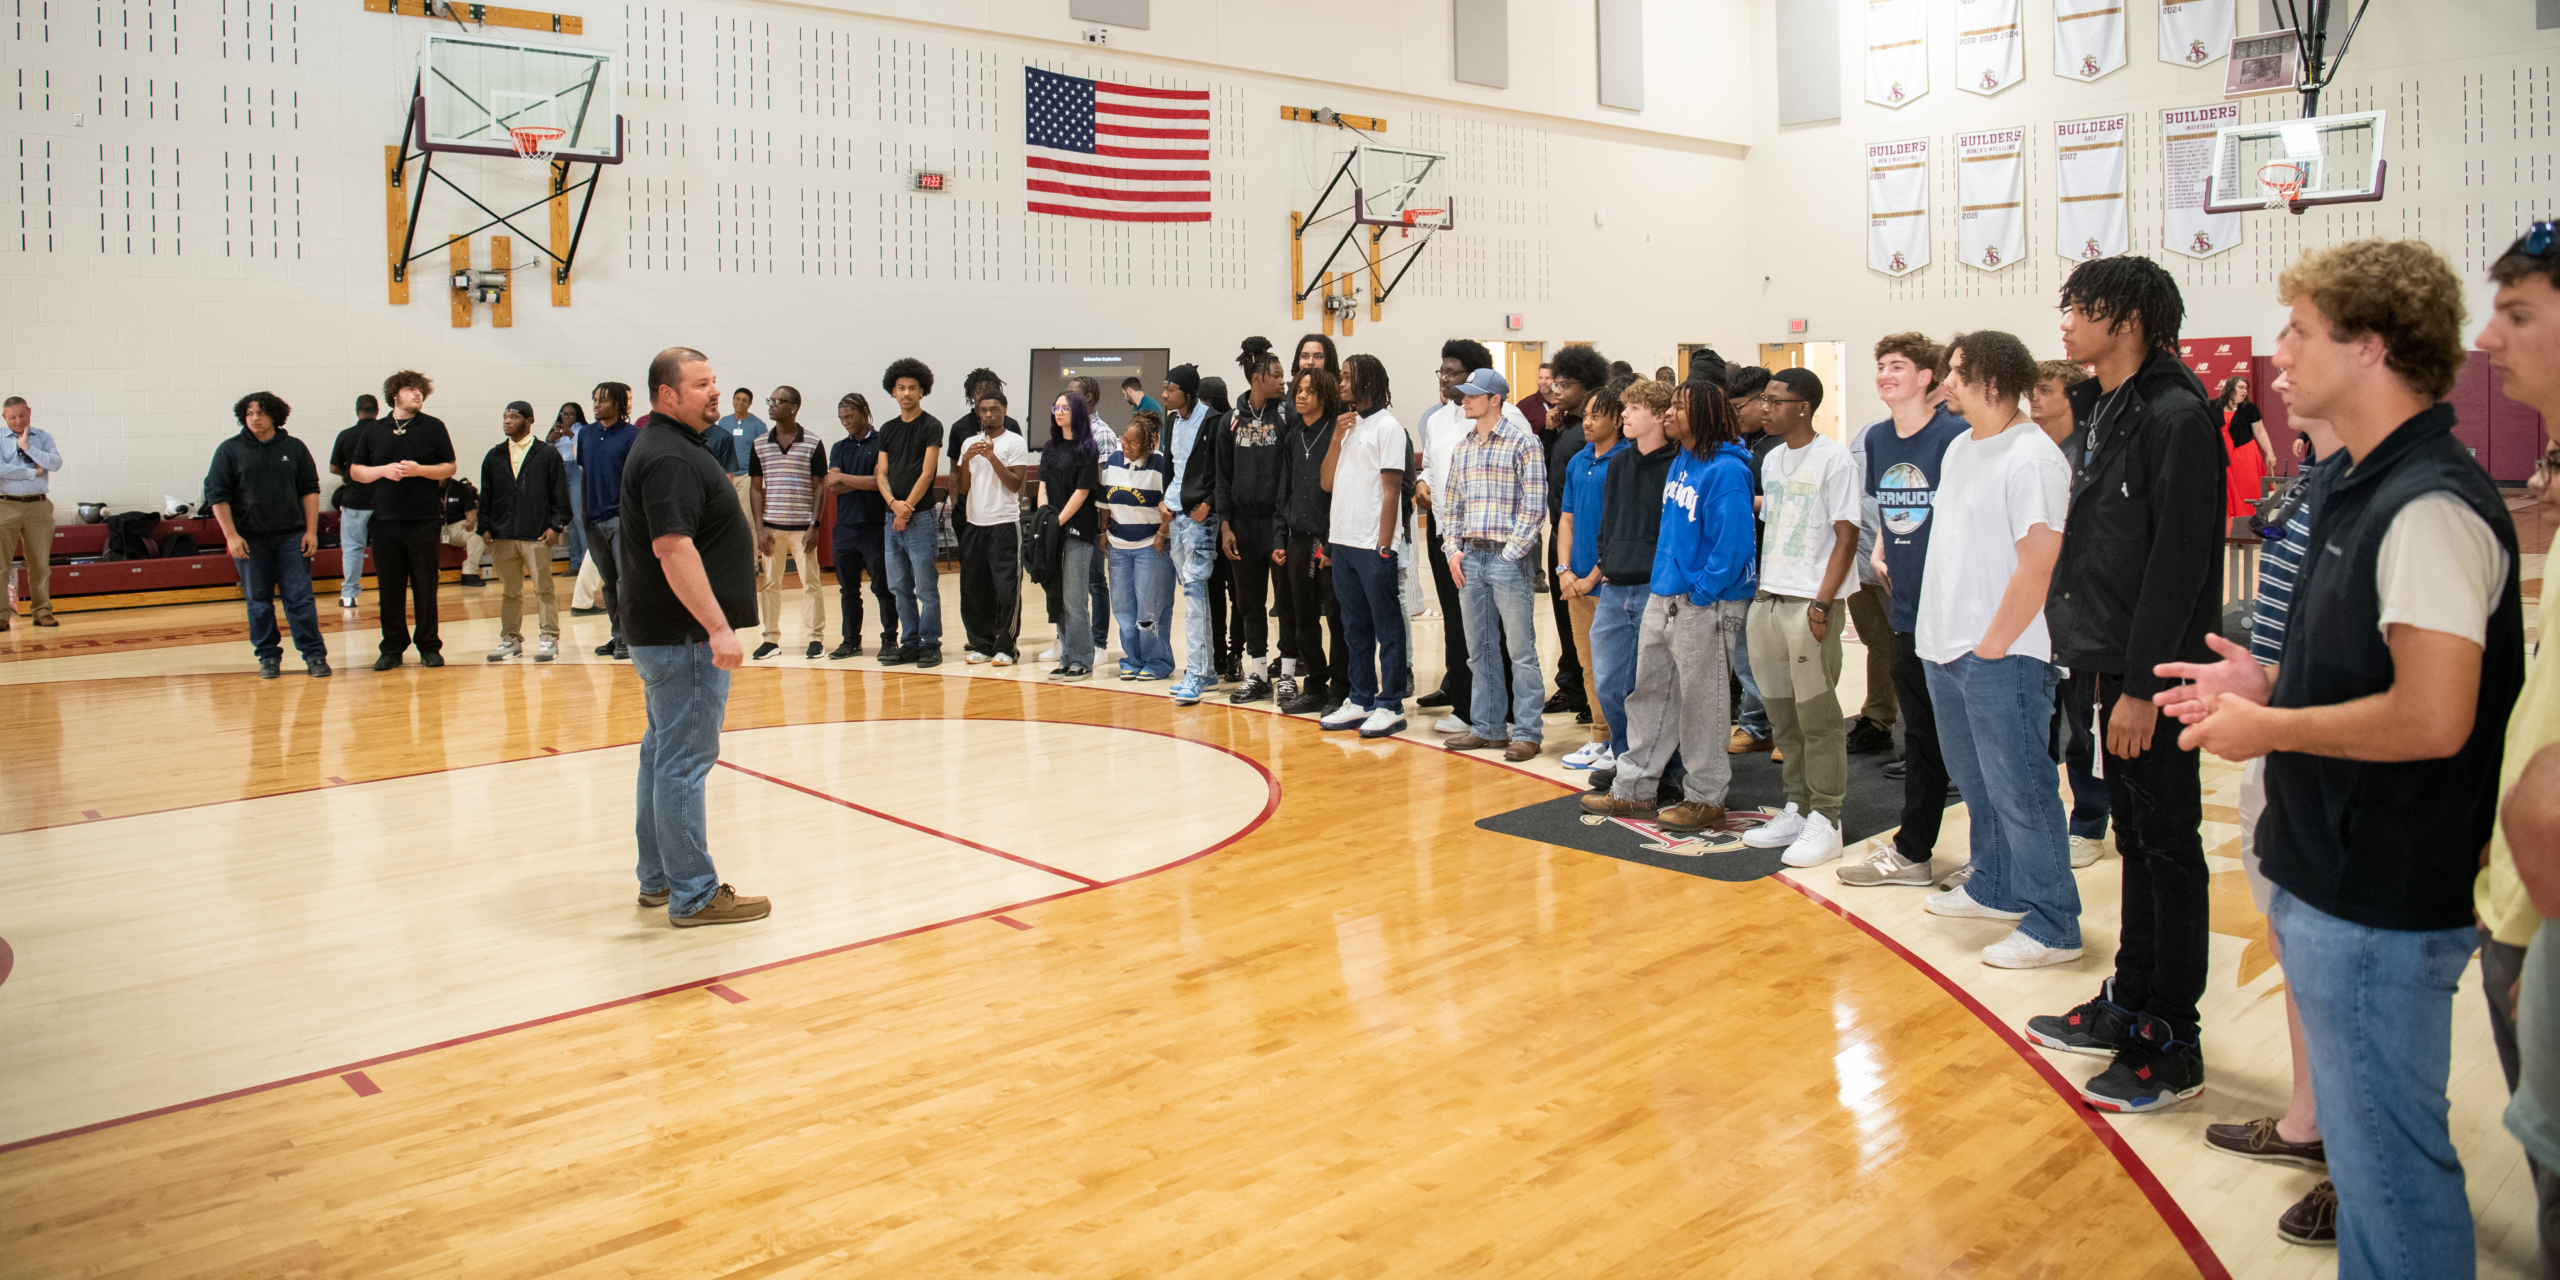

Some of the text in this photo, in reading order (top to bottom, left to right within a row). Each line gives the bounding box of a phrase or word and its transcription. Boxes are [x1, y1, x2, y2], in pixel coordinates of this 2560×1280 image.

[2162, 5, 2182, 14] 2024
[2165, 106, 2237, 124] BUILDERS
[2058, 118, 2124, 136] BUILDERS
[2185, 122, 2216, 131] INDIVIDUAL
[1960, 131, 2021, 147] BUILDERS
[1869, 141, 1926, 157] BUILDERS
[1989, 144, 2015, 152] WRESTLING
